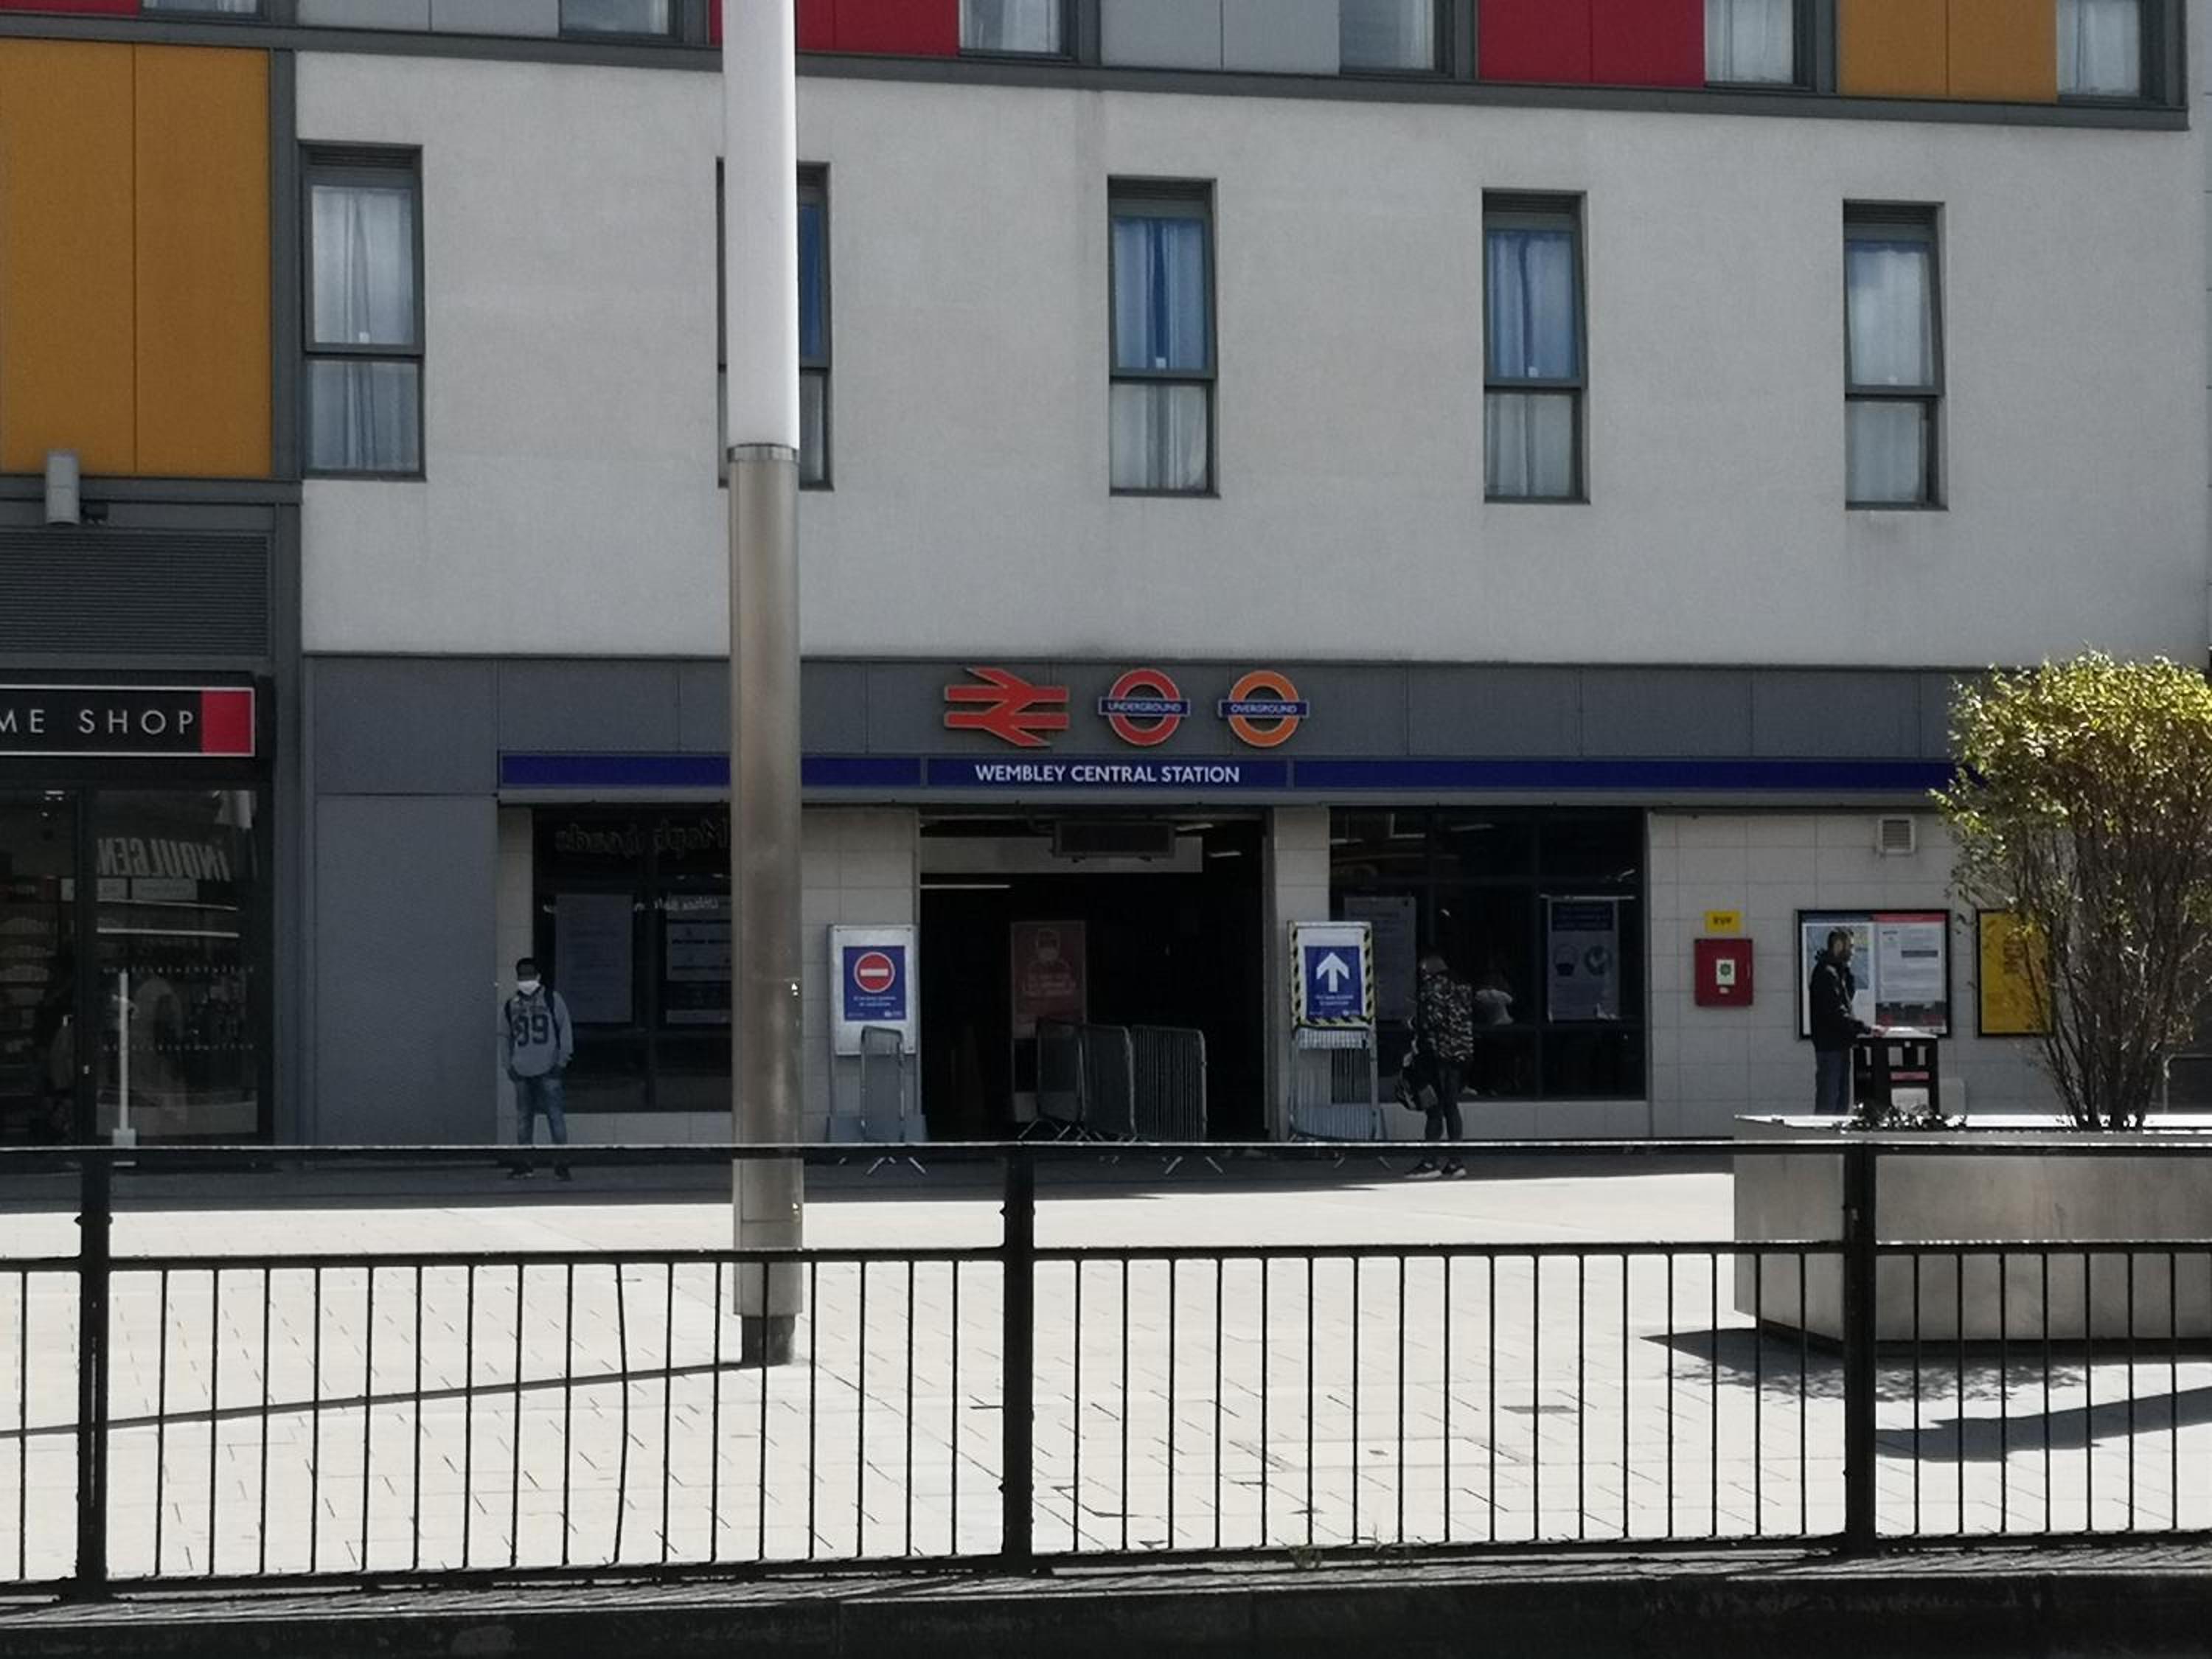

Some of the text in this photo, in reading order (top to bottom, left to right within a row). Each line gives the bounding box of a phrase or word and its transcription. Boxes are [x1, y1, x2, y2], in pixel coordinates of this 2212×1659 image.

[1107, 700, 1182, 712] UNDERGROUND
[1231, 704, 1298, 714] OVERGROUND
[0, 709, 194, 735] ME SHOP
[975, 765, 1240, 783] WEMBLEY CENTRAL STATION
